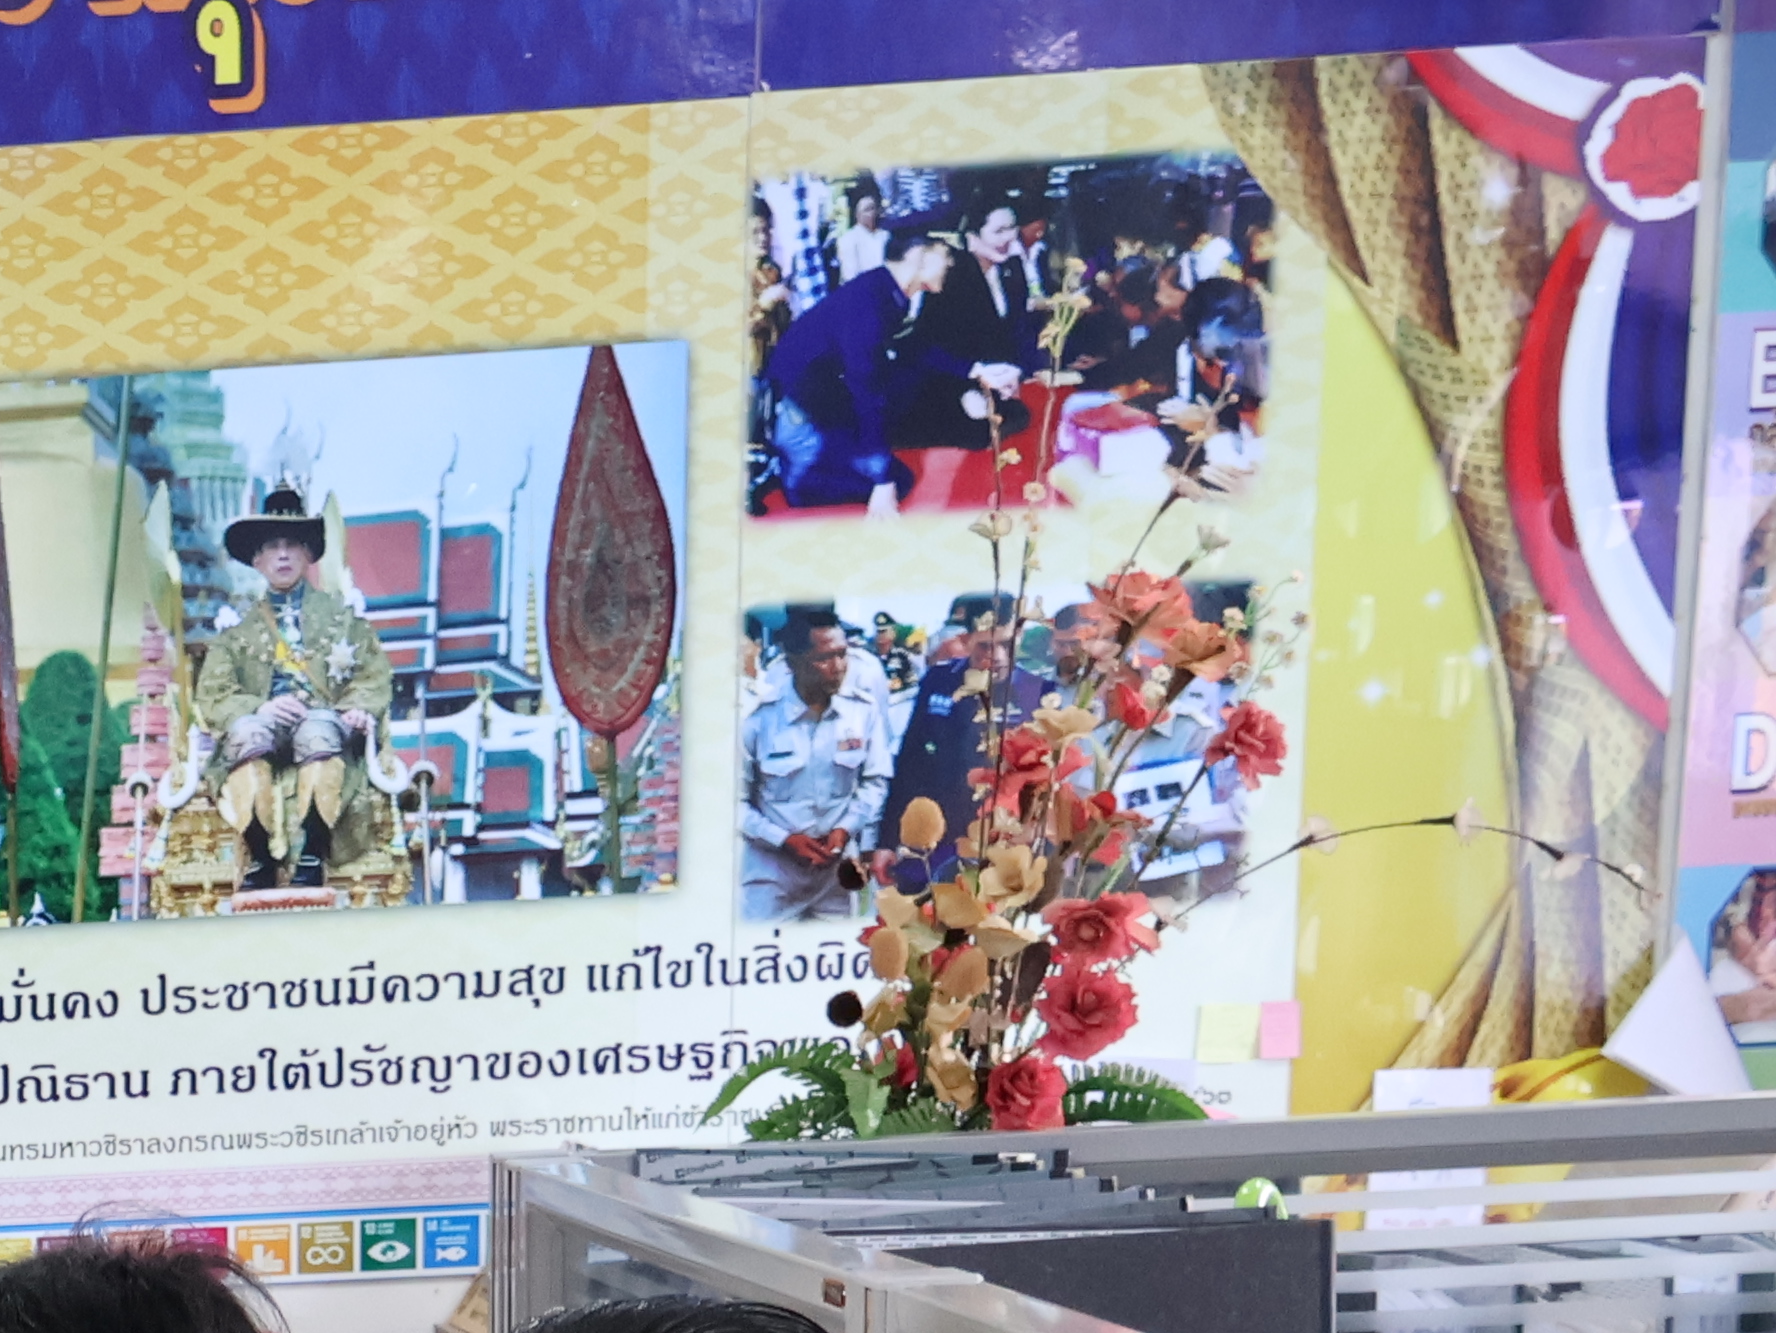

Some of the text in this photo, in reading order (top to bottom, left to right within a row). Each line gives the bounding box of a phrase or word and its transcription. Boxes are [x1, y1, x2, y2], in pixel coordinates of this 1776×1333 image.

[140, 959, 568, 1018] ประชาชนมีความสุข
